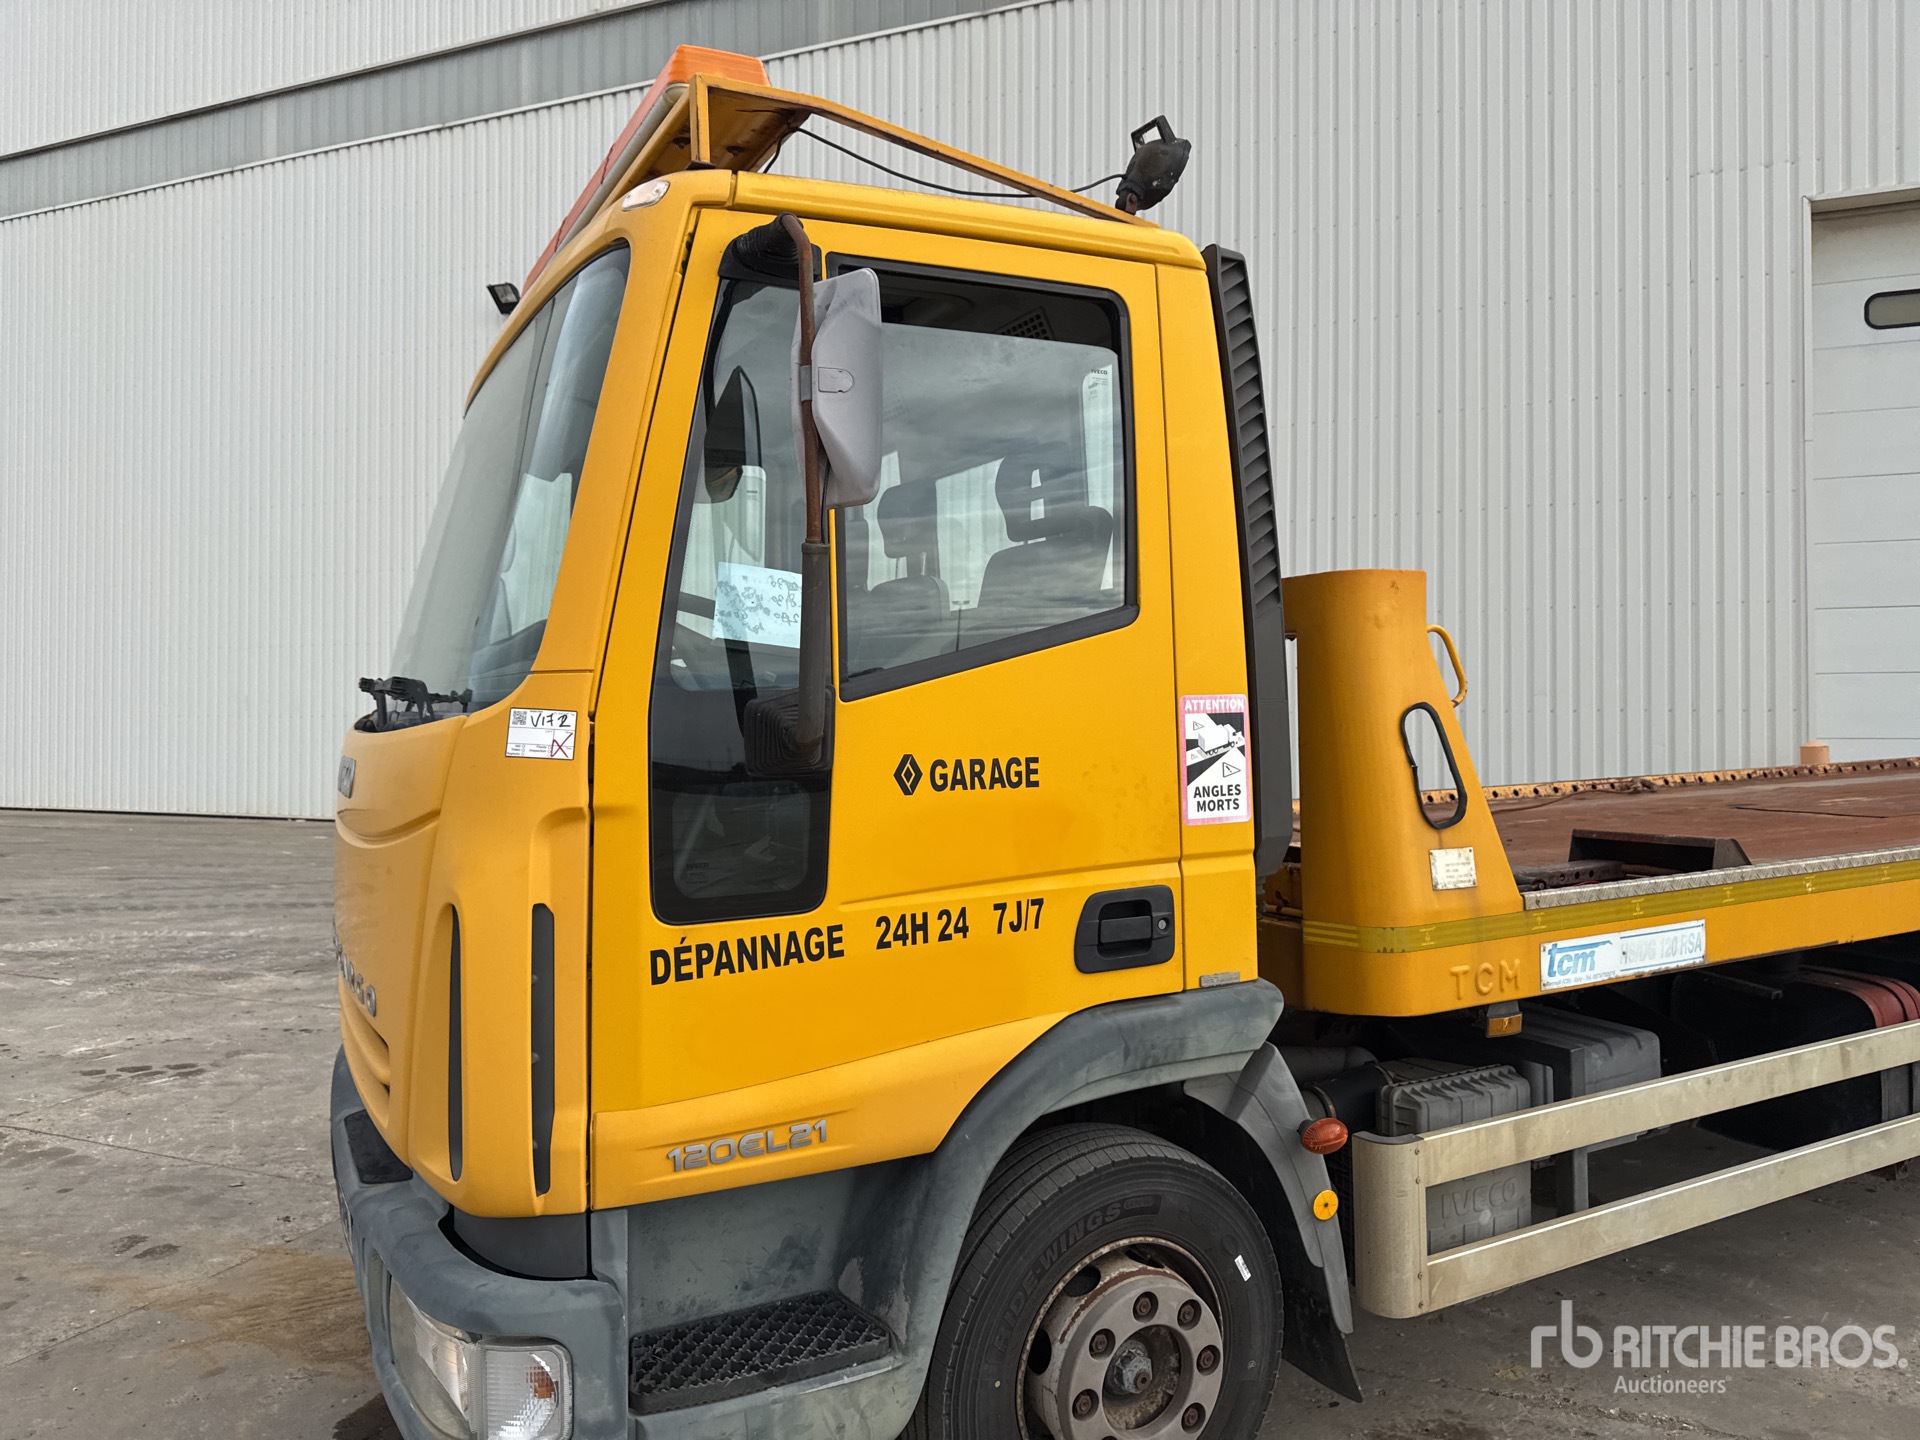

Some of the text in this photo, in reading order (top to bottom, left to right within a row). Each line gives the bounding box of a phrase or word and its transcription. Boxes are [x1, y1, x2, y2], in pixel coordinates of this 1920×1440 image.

[1184, 699, 1245, 711] ATTENTION
[929, 757, 1040, 792] GARAGE
[1193, 784, 1242, 798] ANGLES
[1196, 798, 1240, 812] MORTS
[650, 898, 1045, 986] DÉPANNAGE 24H 24 7J/7
[1660, 936, 1678, 959] 120
[1680, 932, 1703, 956] RSA
[1450, 958, 1521, 1000] TCM
[667, 1119, 827, 1173] 120EL21
[1441, 1176, 1518, 1219] IVECO
